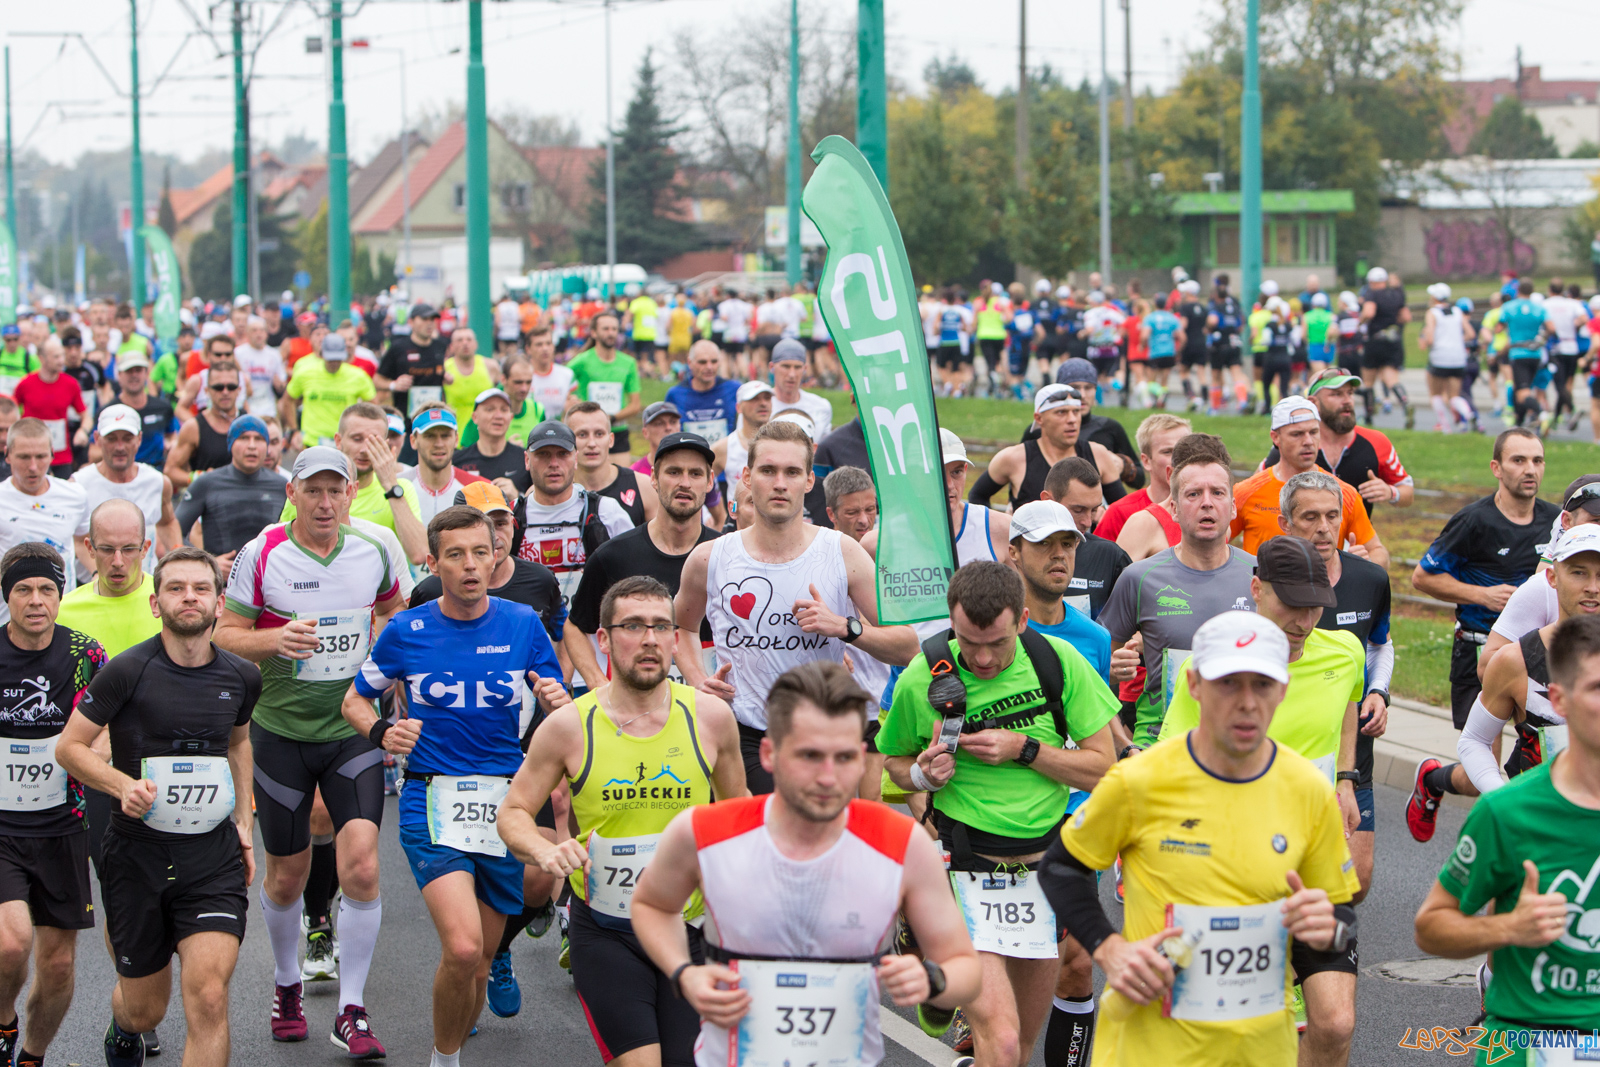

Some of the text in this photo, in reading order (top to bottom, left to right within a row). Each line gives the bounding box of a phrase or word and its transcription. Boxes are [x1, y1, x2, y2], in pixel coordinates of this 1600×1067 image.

[294, 581, 320, 590] REHAU
[314, 633, 360, 654] 5387
[3, 689, 26, 697] SUT
[6, 763, 54, 782] 1799
[166, 785, 219, 805] 5777
[602, 787, 691, 801] SUDECKIE
[452, 802, 498, 824] 2513
[602, 801, 690, 811] WYCIECZKI BIEGOWE
[604, 866, 645, 887] 72
[980, 901, 1036, 924] 7183
[994, 924, 1025, 932] Wojciech
[1201, 944, 1270, 975] 1928
[775, 1006, 836, 1035] 337
